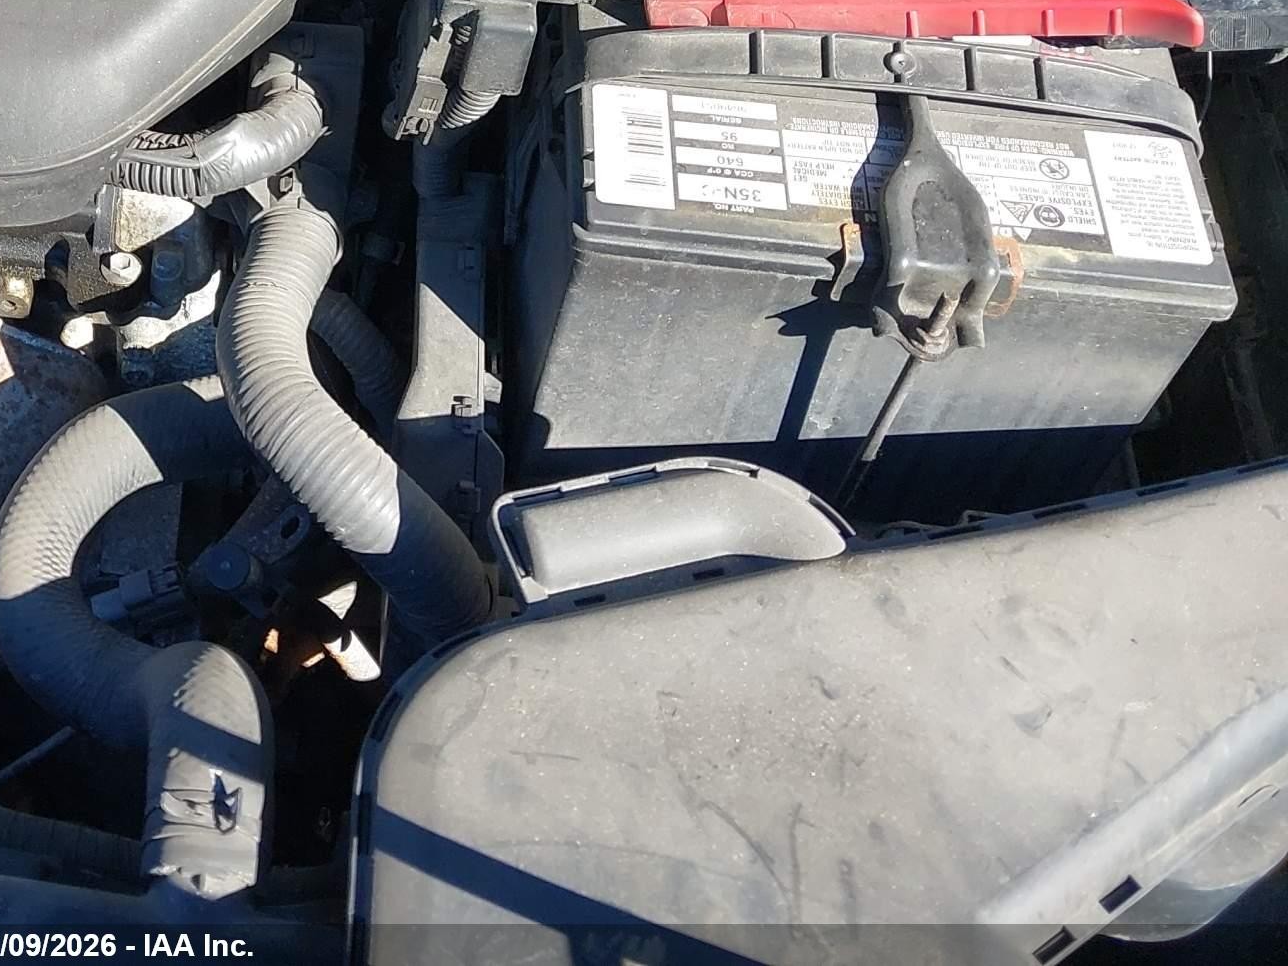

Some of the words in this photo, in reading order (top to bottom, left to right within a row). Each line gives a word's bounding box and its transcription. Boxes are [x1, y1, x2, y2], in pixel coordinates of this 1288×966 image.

[709, 115, 742, 124] SERIAL
[721, 131, 737, 141] 95
[717, 155, 743, 167] 640
[734, 169, 753, 177] CCA
[1018, 194, 1045, 203] GASES
[1048, 196, 1092, 207] EXPLOSIVE
[713, 203, 728, 211] NO.
[730, 205, 754, 213] PART
[1067, 216, 1096, 226] SHIELD
